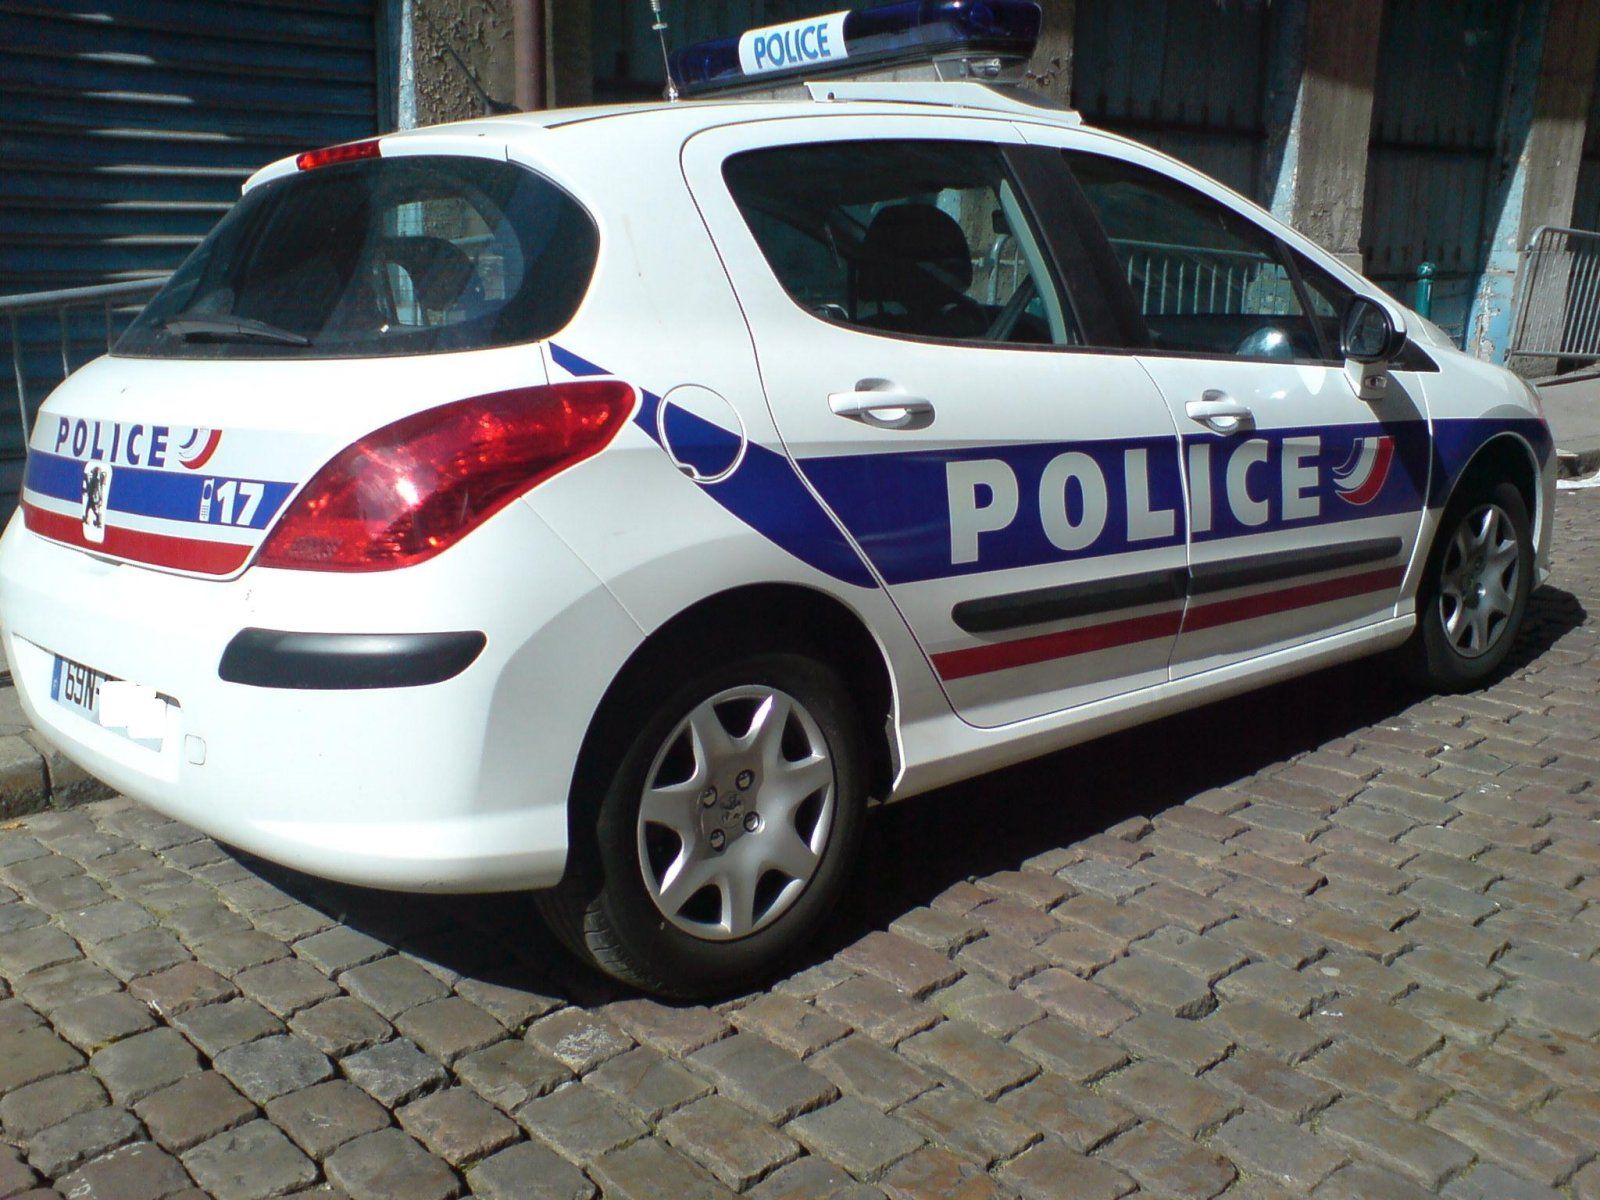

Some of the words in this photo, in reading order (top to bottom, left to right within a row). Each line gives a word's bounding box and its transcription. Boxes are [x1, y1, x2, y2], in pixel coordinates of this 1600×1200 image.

[754, 23, 831, 69] POLICE
[56, 417, 169, 467] POLICE
[217, 481, 264, 526] 17
[945, 436, 1320, 565] POLICE
